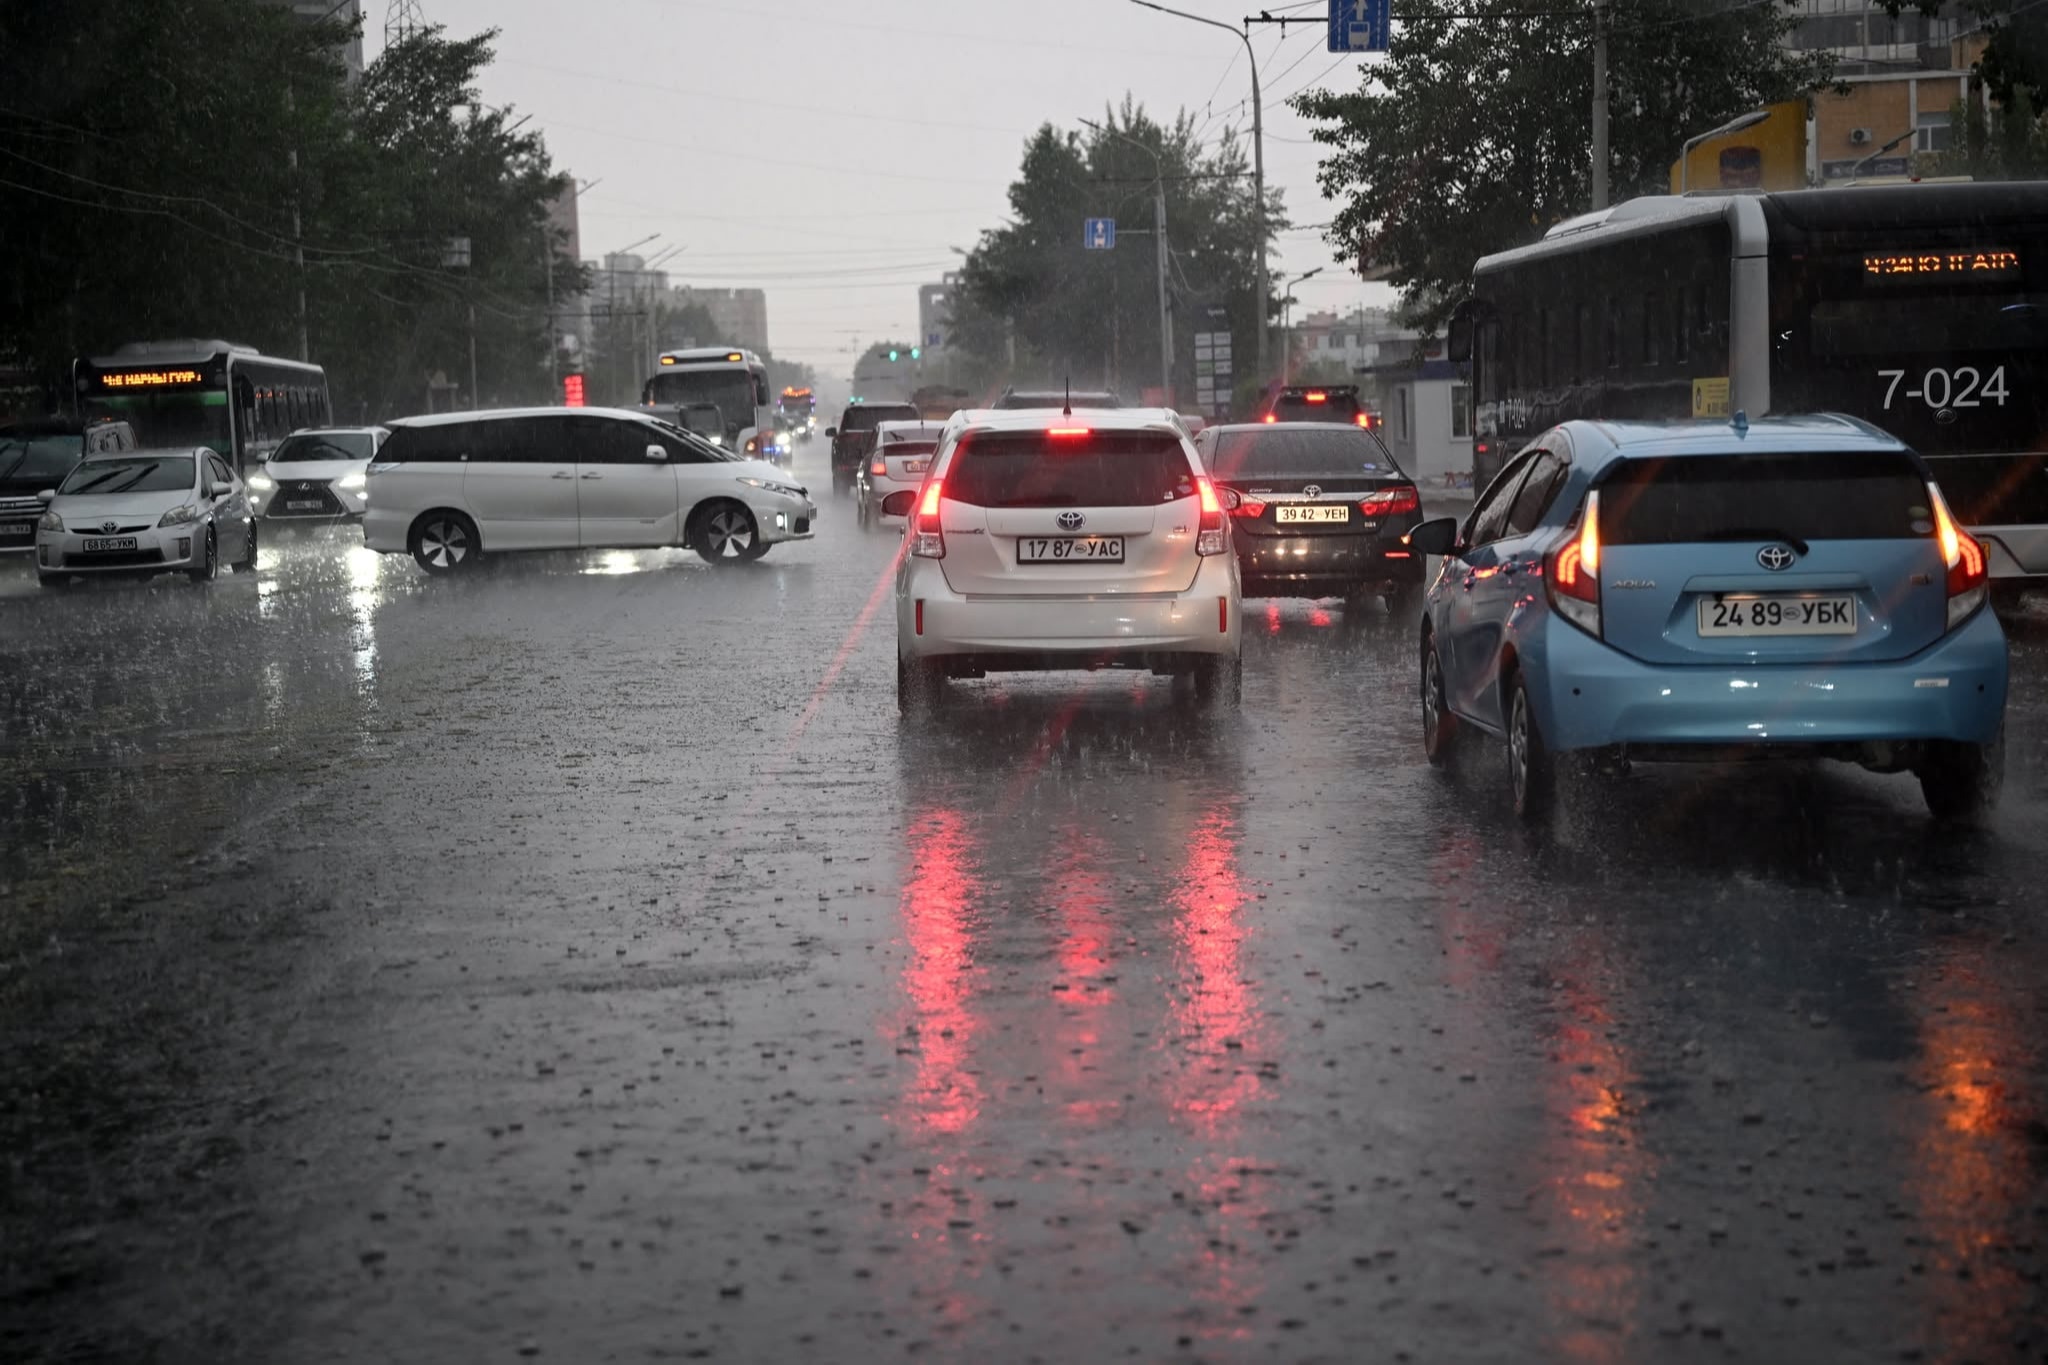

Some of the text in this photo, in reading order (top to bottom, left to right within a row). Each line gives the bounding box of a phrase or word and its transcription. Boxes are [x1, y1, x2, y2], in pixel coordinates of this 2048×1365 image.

[1877, 365, 2010, 410] 7-024
[1283, 508, 1346, 520] 39 42 УЕН
[1028, 540, 1048, 558] 17
[1053, 540, 1074, 558] 87
[1087, 540, 1119, 557] УАС
[1712, 602, 1744, 627] 24
[1751, 602, 1782, 626] 89
[1801, 602, 1849, 624] УБК
